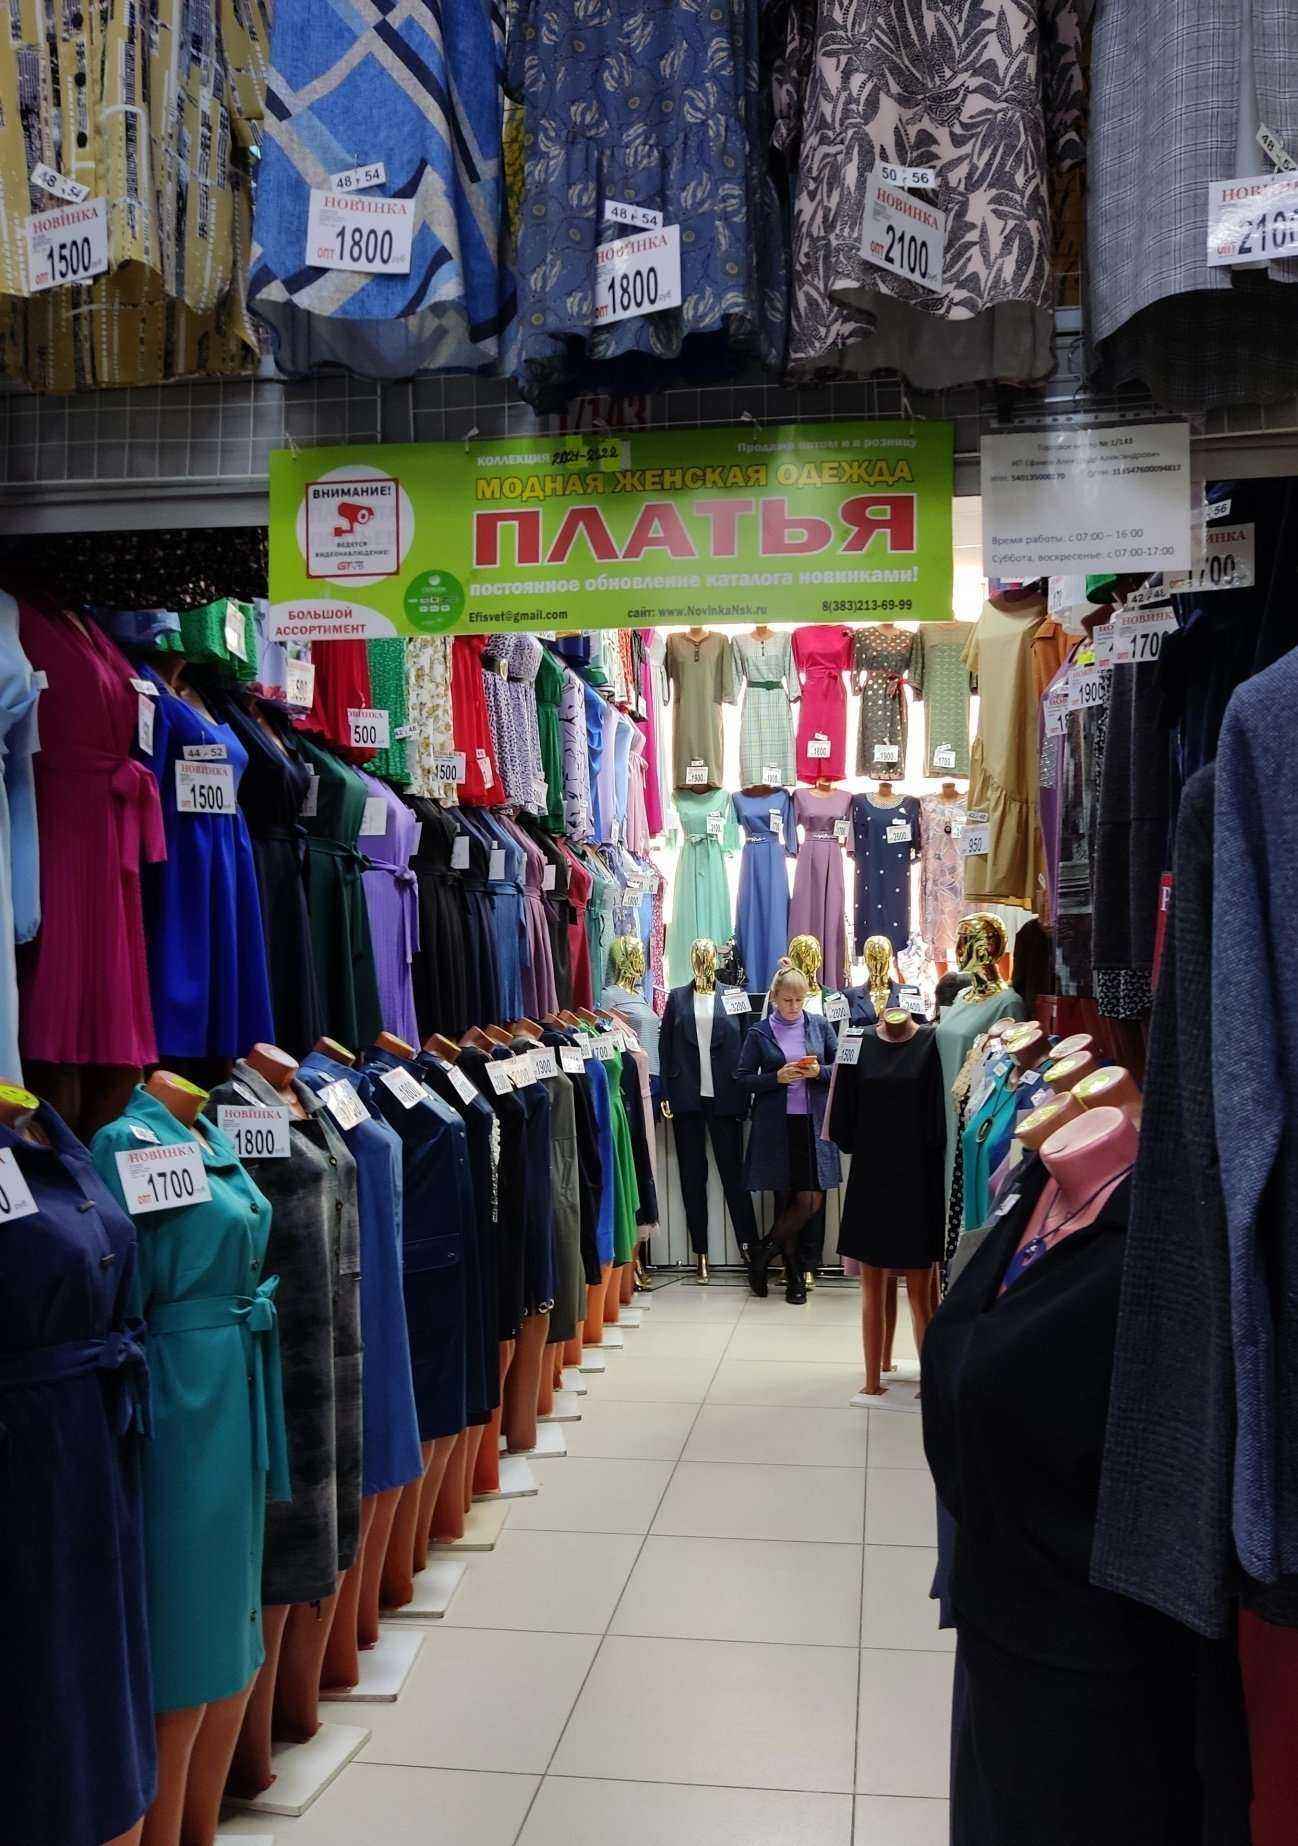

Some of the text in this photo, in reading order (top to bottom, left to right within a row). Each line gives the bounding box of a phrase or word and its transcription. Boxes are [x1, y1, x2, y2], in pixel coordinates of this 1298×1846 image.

[336, 168, 380, 188] 48 54
[882, 166, 929, 184] 50 56
[322, 195, 408, 216] НОВИНКА
[876, 187, 939, 231] НОВИНКА
[33, 206, 98, 233] НОВИНКА
[610, 207, 658, 226] 48 54
[335, 224, 393, 265] 1800
[884, 223, 929, 280] 2100
[47, 236, 92, 281] 1500
[607, 266, 659, 315] 1800
[476, 458, 915, 503] МОДНАЯ ЖЕНСКАЯ ОДЕЖДА
[312, 486, 391, 500] ВНИМАНИЕ!
[1214, 503, 1228, 515] 56
[473, 492, 918, 568] ПЛАТЬЯ
[1075, 532, 1104, 542] 07:00
[1116, 528, 1144, 539] 16:00
[470, 566, 918, 597] постоянное обновление каталога новинками!
[288, 606, 352, 621] БОЛЬШОЙ
[822, 598, 913, 612] 8(383)213-69-99
[469, 608, 568, 624] Efisvet@gmail.com
[275, 624, 367, 637] АССОРТИМЕНТ
[187, 748, 223, 758] 44 52
[190, 783, 224, 811] 1500
[224, 1109, 282, 1120] НОВИНКА
[234, 1128, 275, 1156] 1800
[128, 1145, 196, 1164] НОВИНКА
[147, 1167, 194, 1202] 1700
